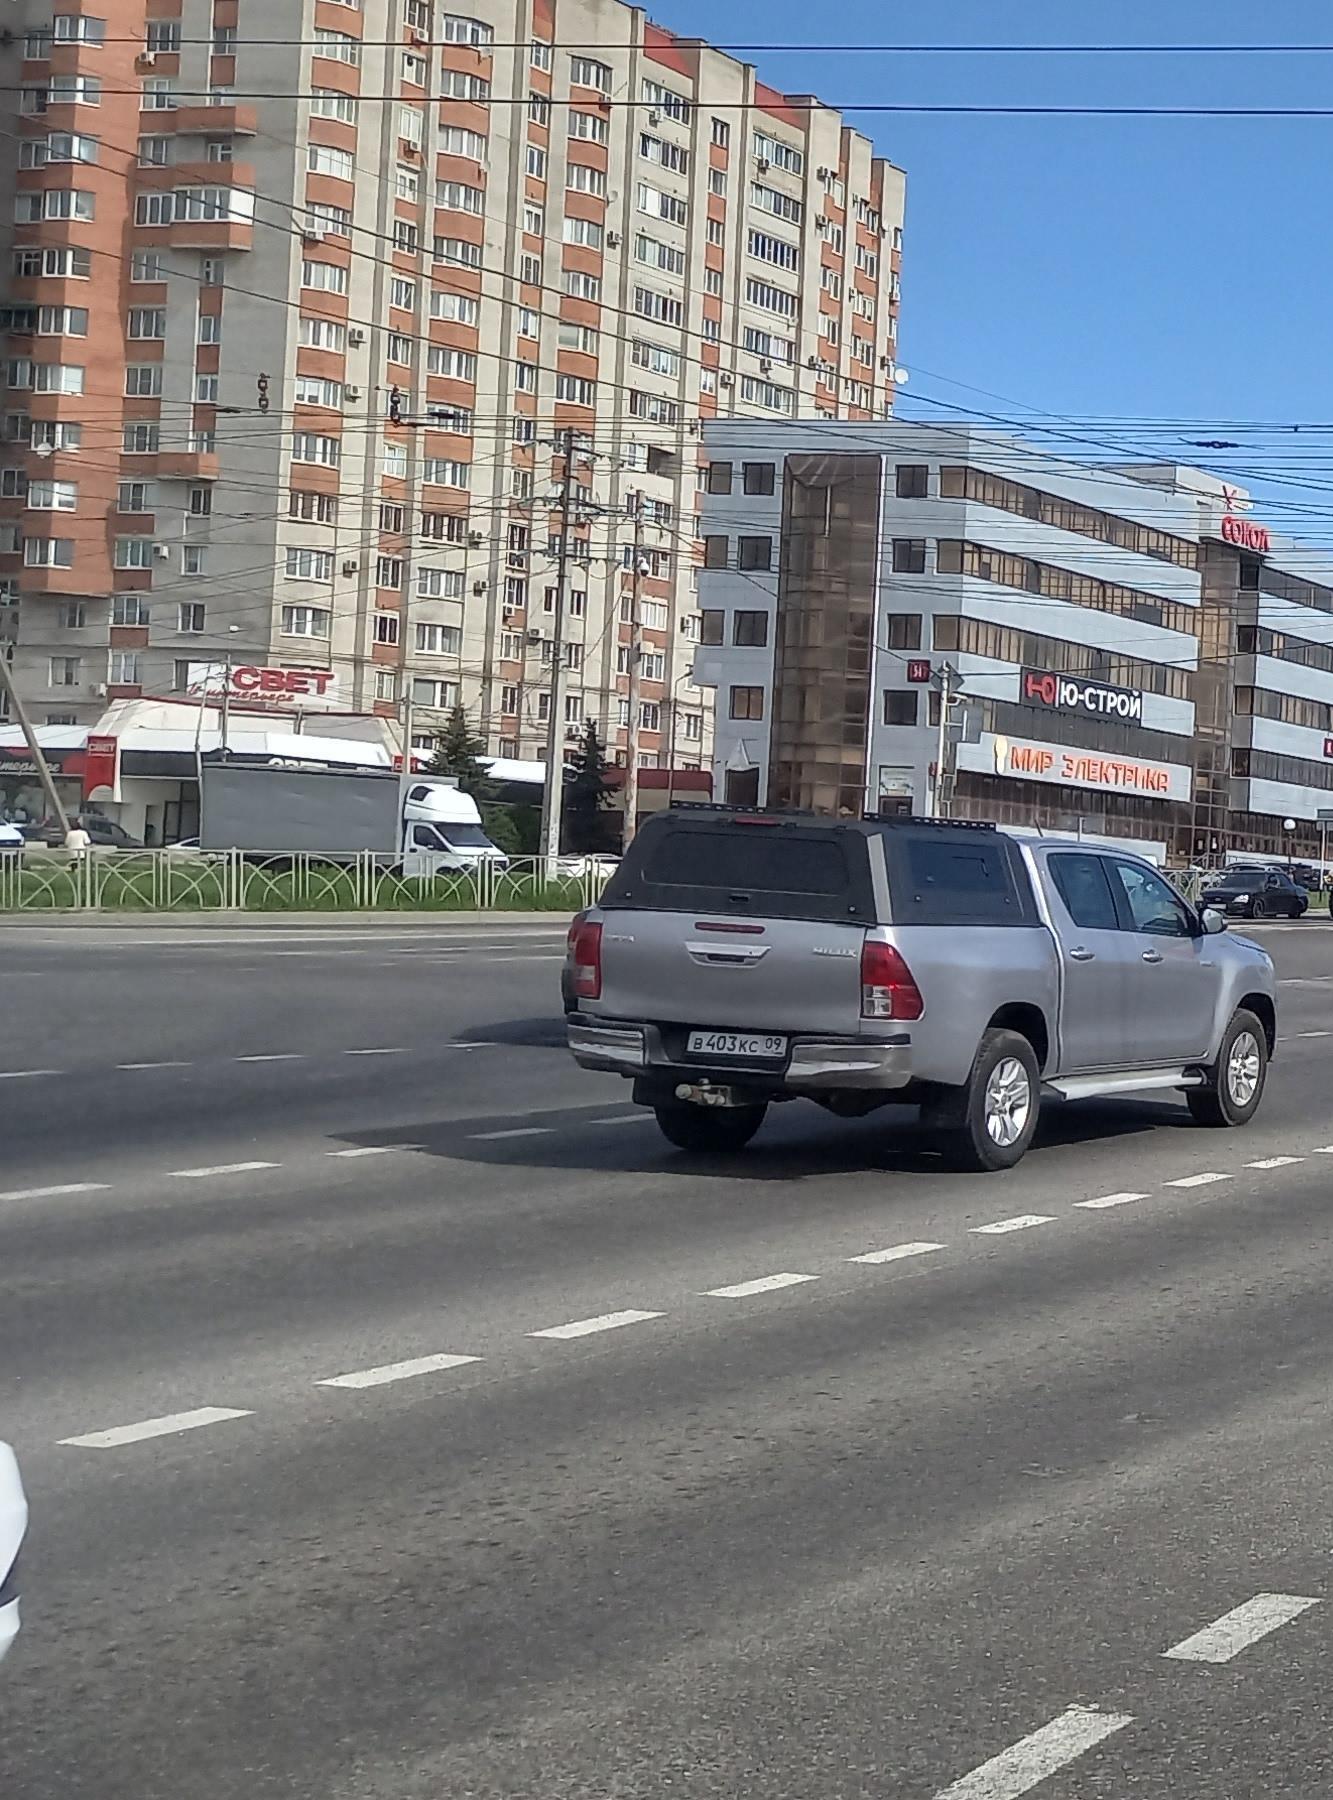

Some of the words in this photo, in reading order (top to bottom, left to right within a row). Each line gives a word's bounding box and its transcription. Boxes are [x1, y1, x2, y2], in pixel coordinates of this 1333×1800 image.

[231, 666, 335, 696] СВЕТ
[1060, 681, 1142, 719] Ю-СТРОЙ
[1010, 746, 1053, 774] МИР
[1061, 754, 1170, 793] ЭЛЕКТРИКА
[765, 1037, 783, 1050] 09
